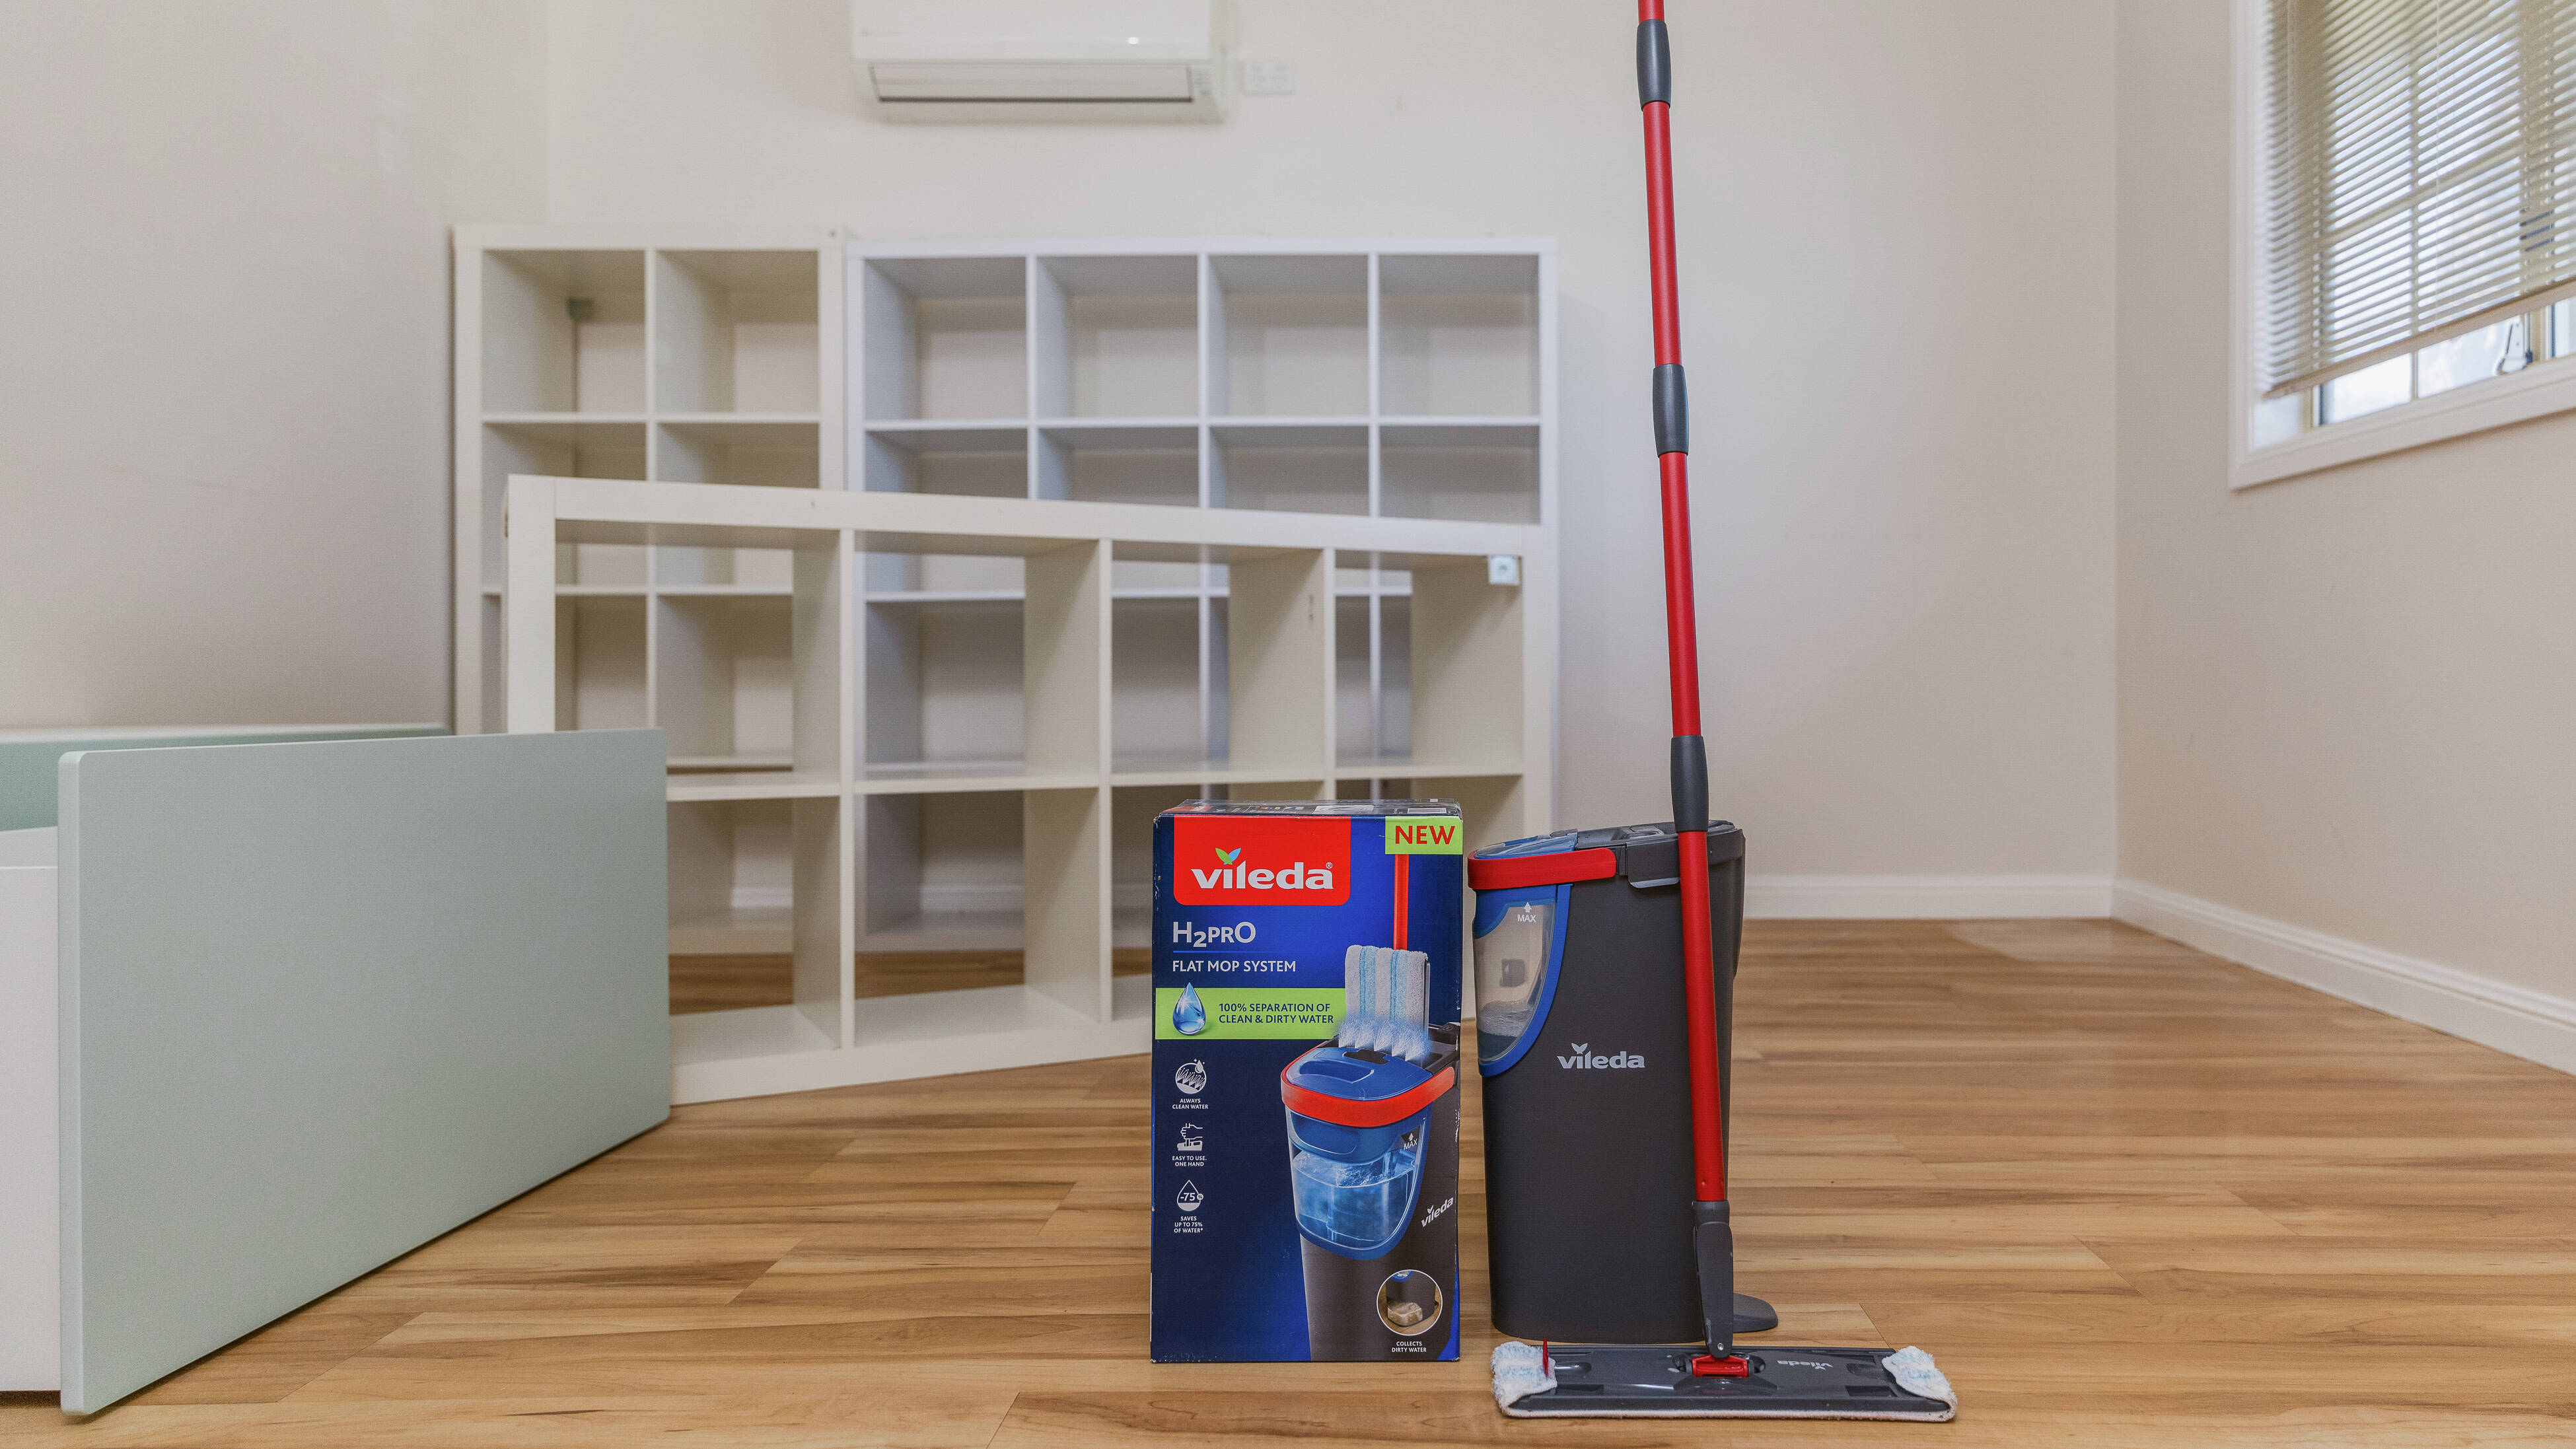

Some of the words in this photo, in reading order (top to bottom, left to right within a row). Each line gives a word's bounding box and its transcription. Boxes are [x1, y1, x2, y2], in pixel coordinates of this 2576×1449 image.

[1396, 826, 1454, 844] NEW
[1517, 914, 1536, 923] MAX
[1172, 960, 1204, 972] FLAT
[1207, 960, 1238, 972] MOP
[1243, 960, 1296, 972] SYSTEM
[1219, 1003, 1246, 1012] 100%
[1250, 1003, 1313, 1012] SEPARATION
[1316, 1003, 1330, 1012] OF
[1219, 1014, 1252, 1023] CLEAN
[1255, 1014, 1264, 1023] &
[1266, 1014, 1296, 1023] DIRTY
[1299, 1014, 1334, 1023] WATER
[1557, 1051, 1645, 1069] vileda
[1404, 1139, 1417, 1150] MAX
[1421, 1197, 1453, 1228] vileda
